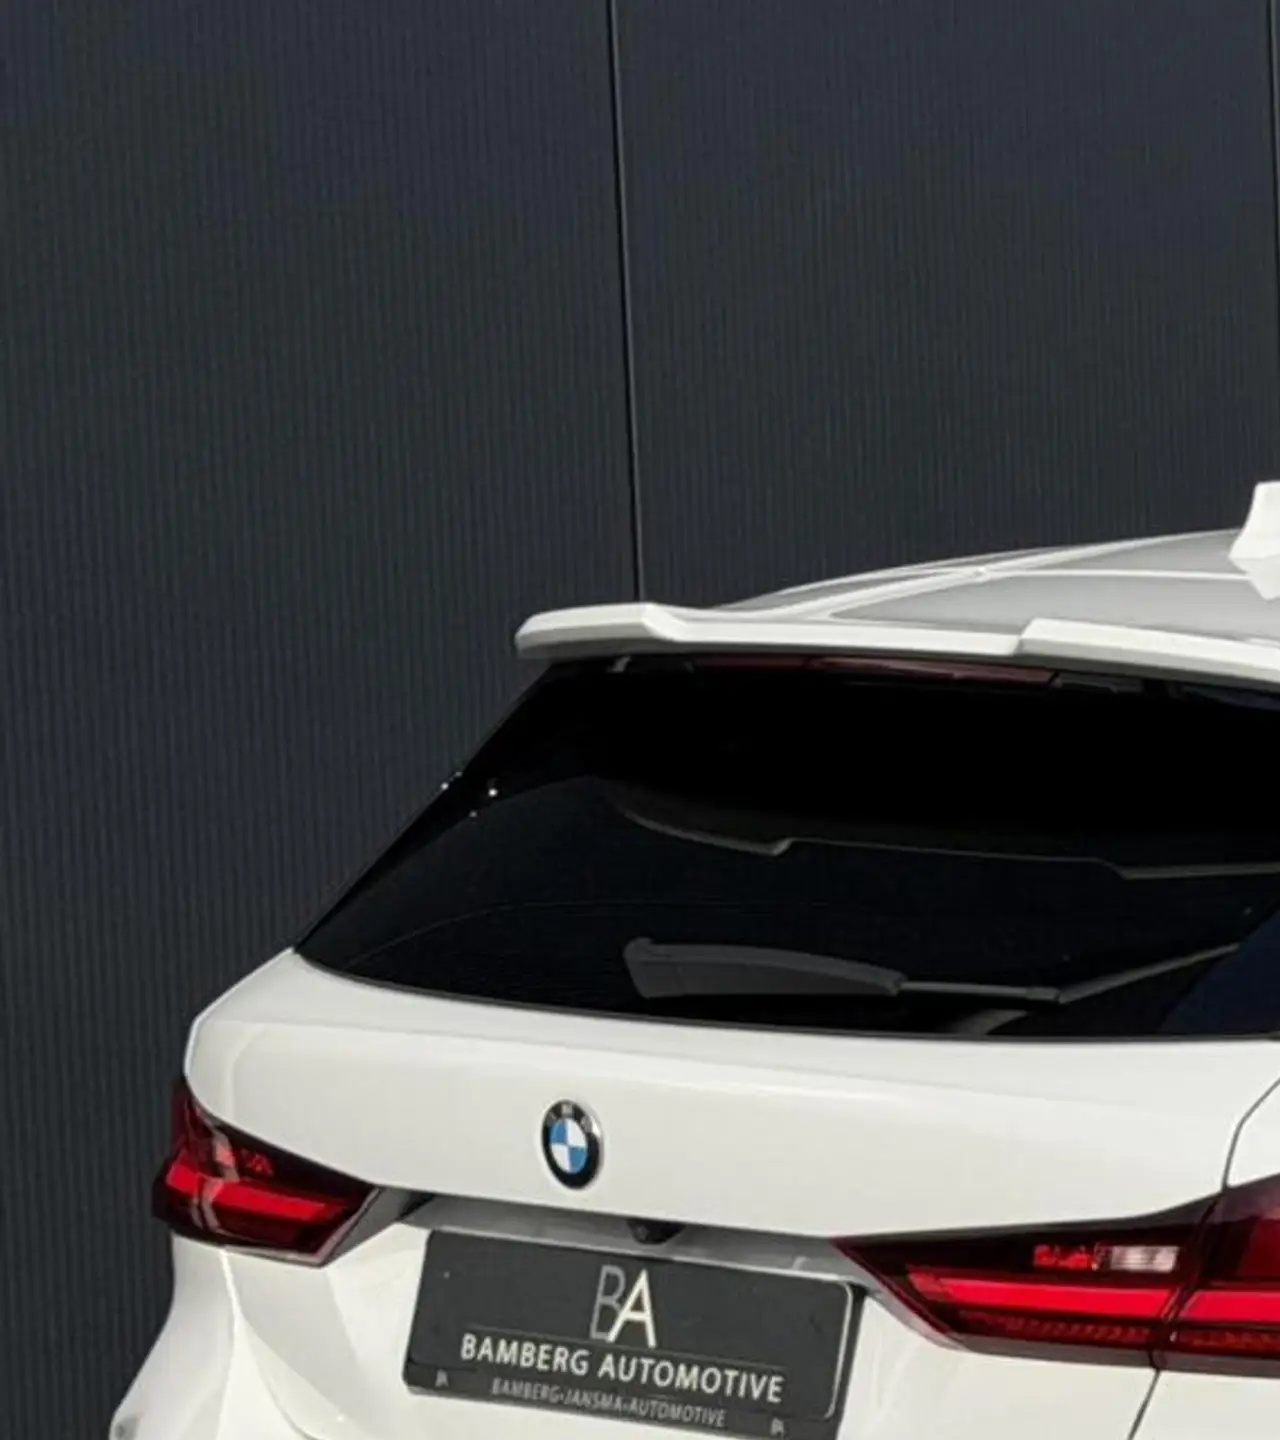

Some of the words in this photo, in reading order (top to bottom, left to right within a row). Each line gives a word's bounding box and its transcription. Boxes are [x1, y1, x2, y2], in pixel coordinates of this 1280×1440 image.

[590, 1264, 657, 1348] BA
[460, 1332, 591, 1376] BAMBERG
[597, 1353, 785, 1404] AUTOMOTIVE
